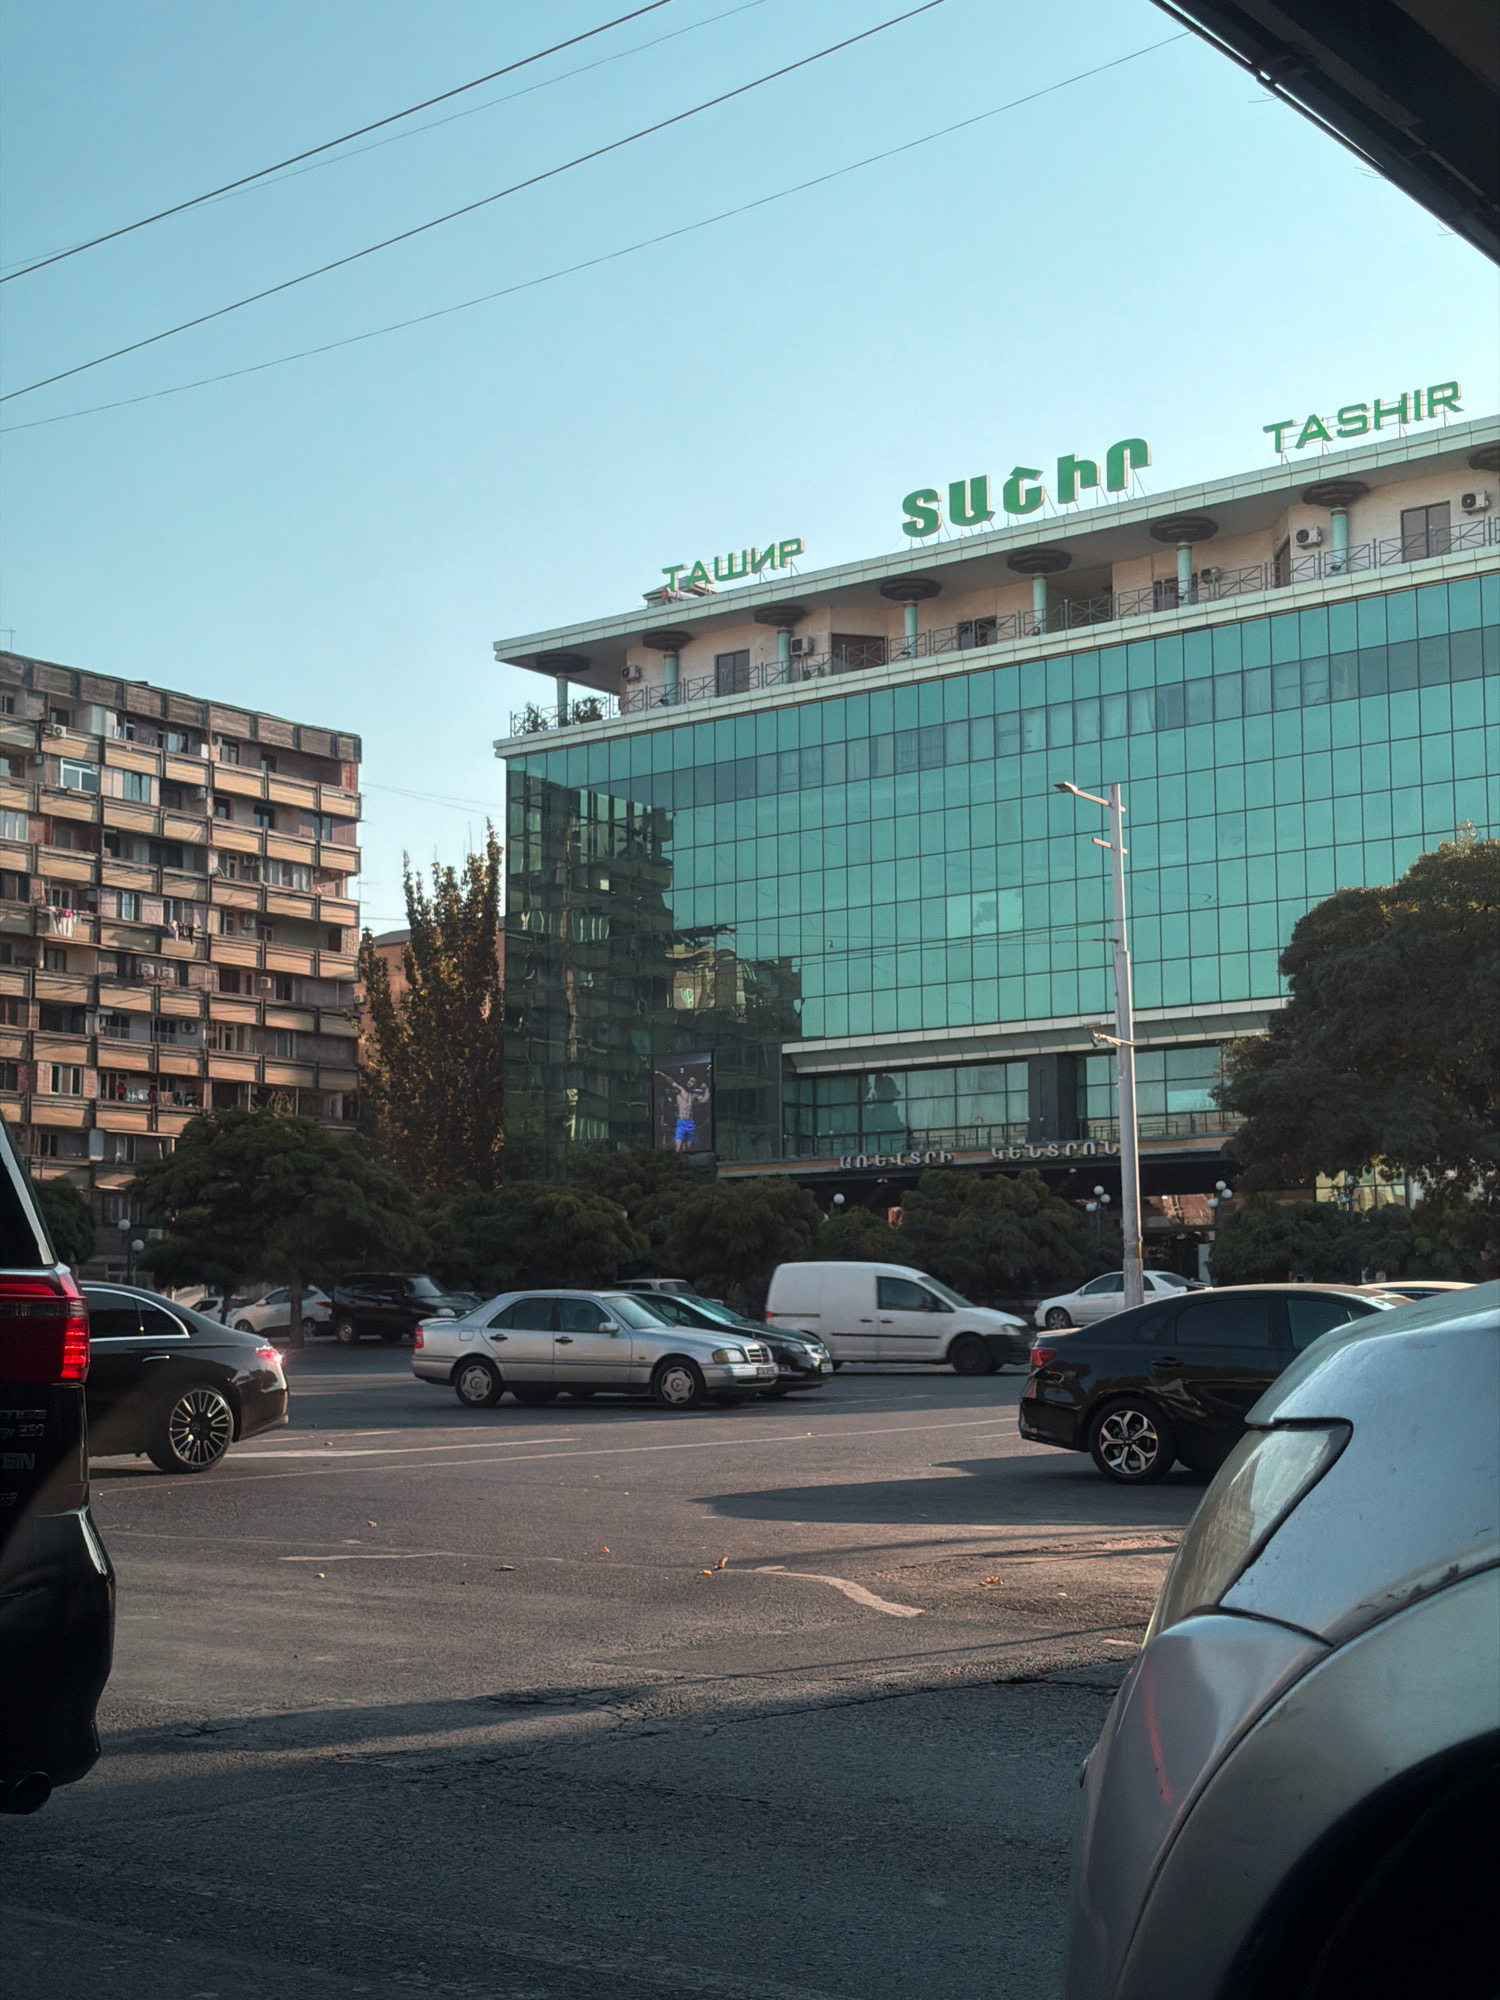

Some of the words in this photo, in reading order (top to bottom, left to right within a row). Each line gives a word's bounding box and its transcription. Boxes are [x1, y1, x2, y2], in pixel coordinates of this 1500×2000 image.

[1263, 380, 1464, 454] TASHIR
[902, 437, 1151, 538] ՏԱՇԻՐ
[662, 537, 804, 592] ТАШИР
